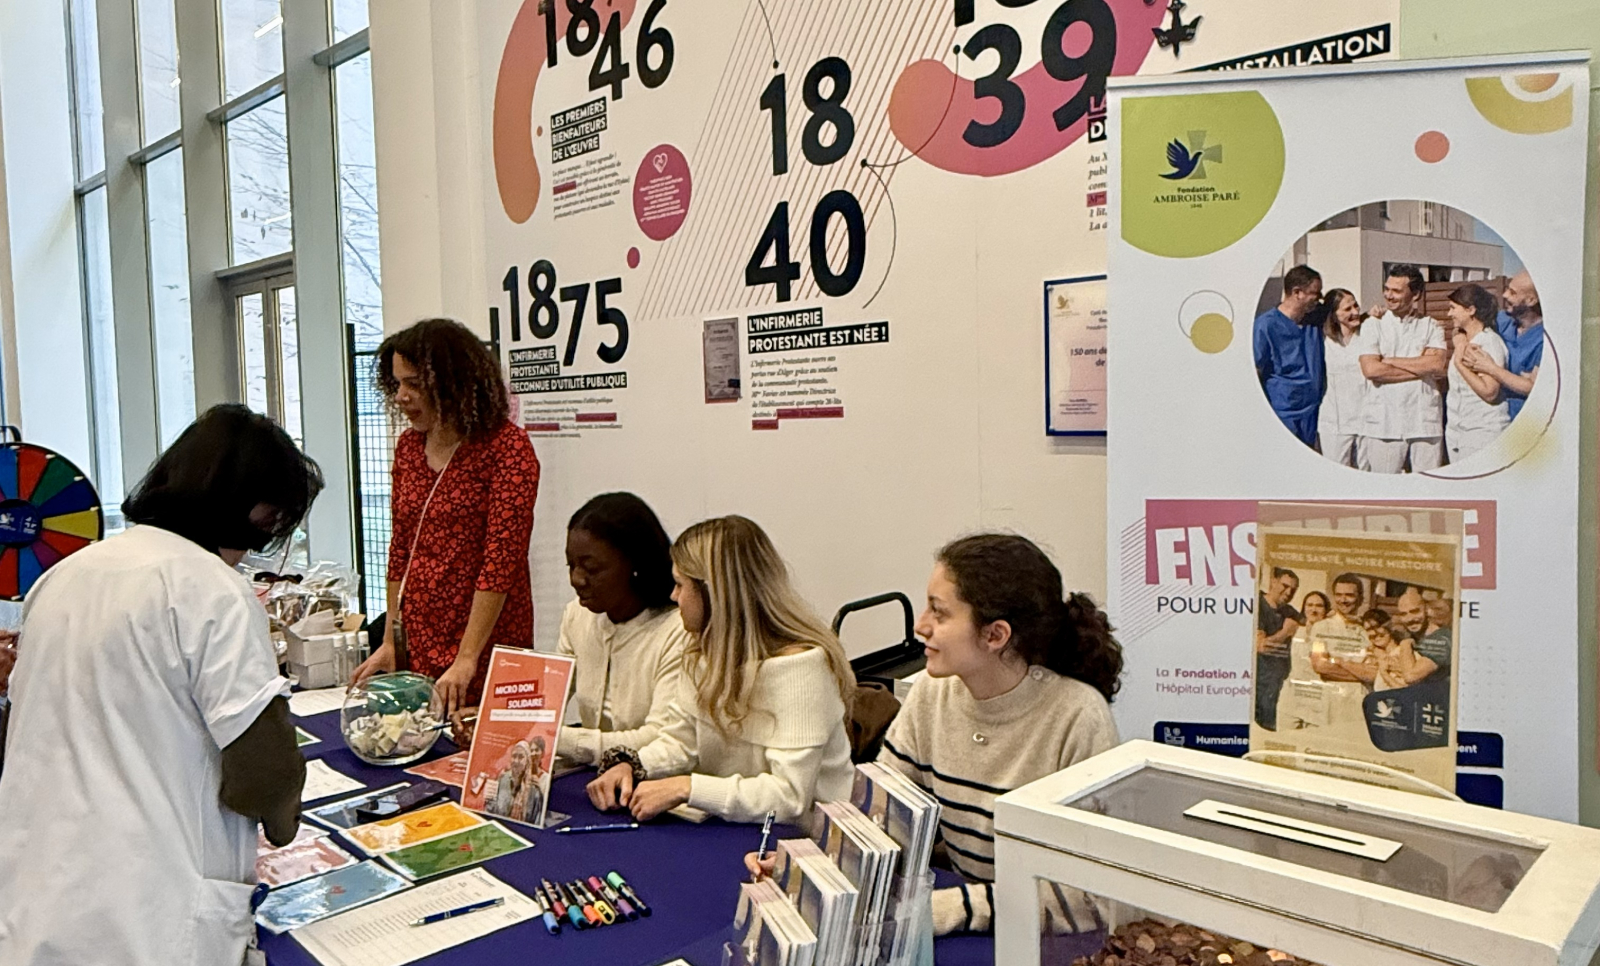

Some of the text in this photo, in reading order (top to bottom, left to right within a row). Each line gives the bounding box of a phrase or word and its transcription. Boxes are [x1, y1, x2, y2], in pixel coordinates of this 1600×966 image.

[551, 100, 605, 129] LES PREMIERS
[760, 56, 855, 176] 18
[552, 117, 606, 145] BIENFAITEURS
[553, 148, 563, 161] DE
[1153, 190, 1240, 203] AMBROISE PARÉ
[745, 190, 866, 303] 40
[503, 259, 629, 367] 1875
[748, 311, 821, 332] L'INFIRMERIE
[750, 335, 827, 352] PROTESTANTE
[829, 330, 851, 345] EST
[853, 325, 879, 342] NÉE
[509, 348, 555, 363] L'INFIRMERIE
[510, 364, 558, 377] PROTESTANTE
[511, 374, 626, 393] RECONNUE D'UTILITÉ PUBLIQUE
[1157, 596, 1216, 614] POUR
[1459, 601, 1481, 619] TE
[1156, 668, 1169, 678] La
[1175, 668, 1236, 679] Fondation
[495, 683, 535, 695] MICRO DON
[1156, 682, 1203, 695] l'Hôpital
[507, 698, 543, 709] SOLIDAIRE
